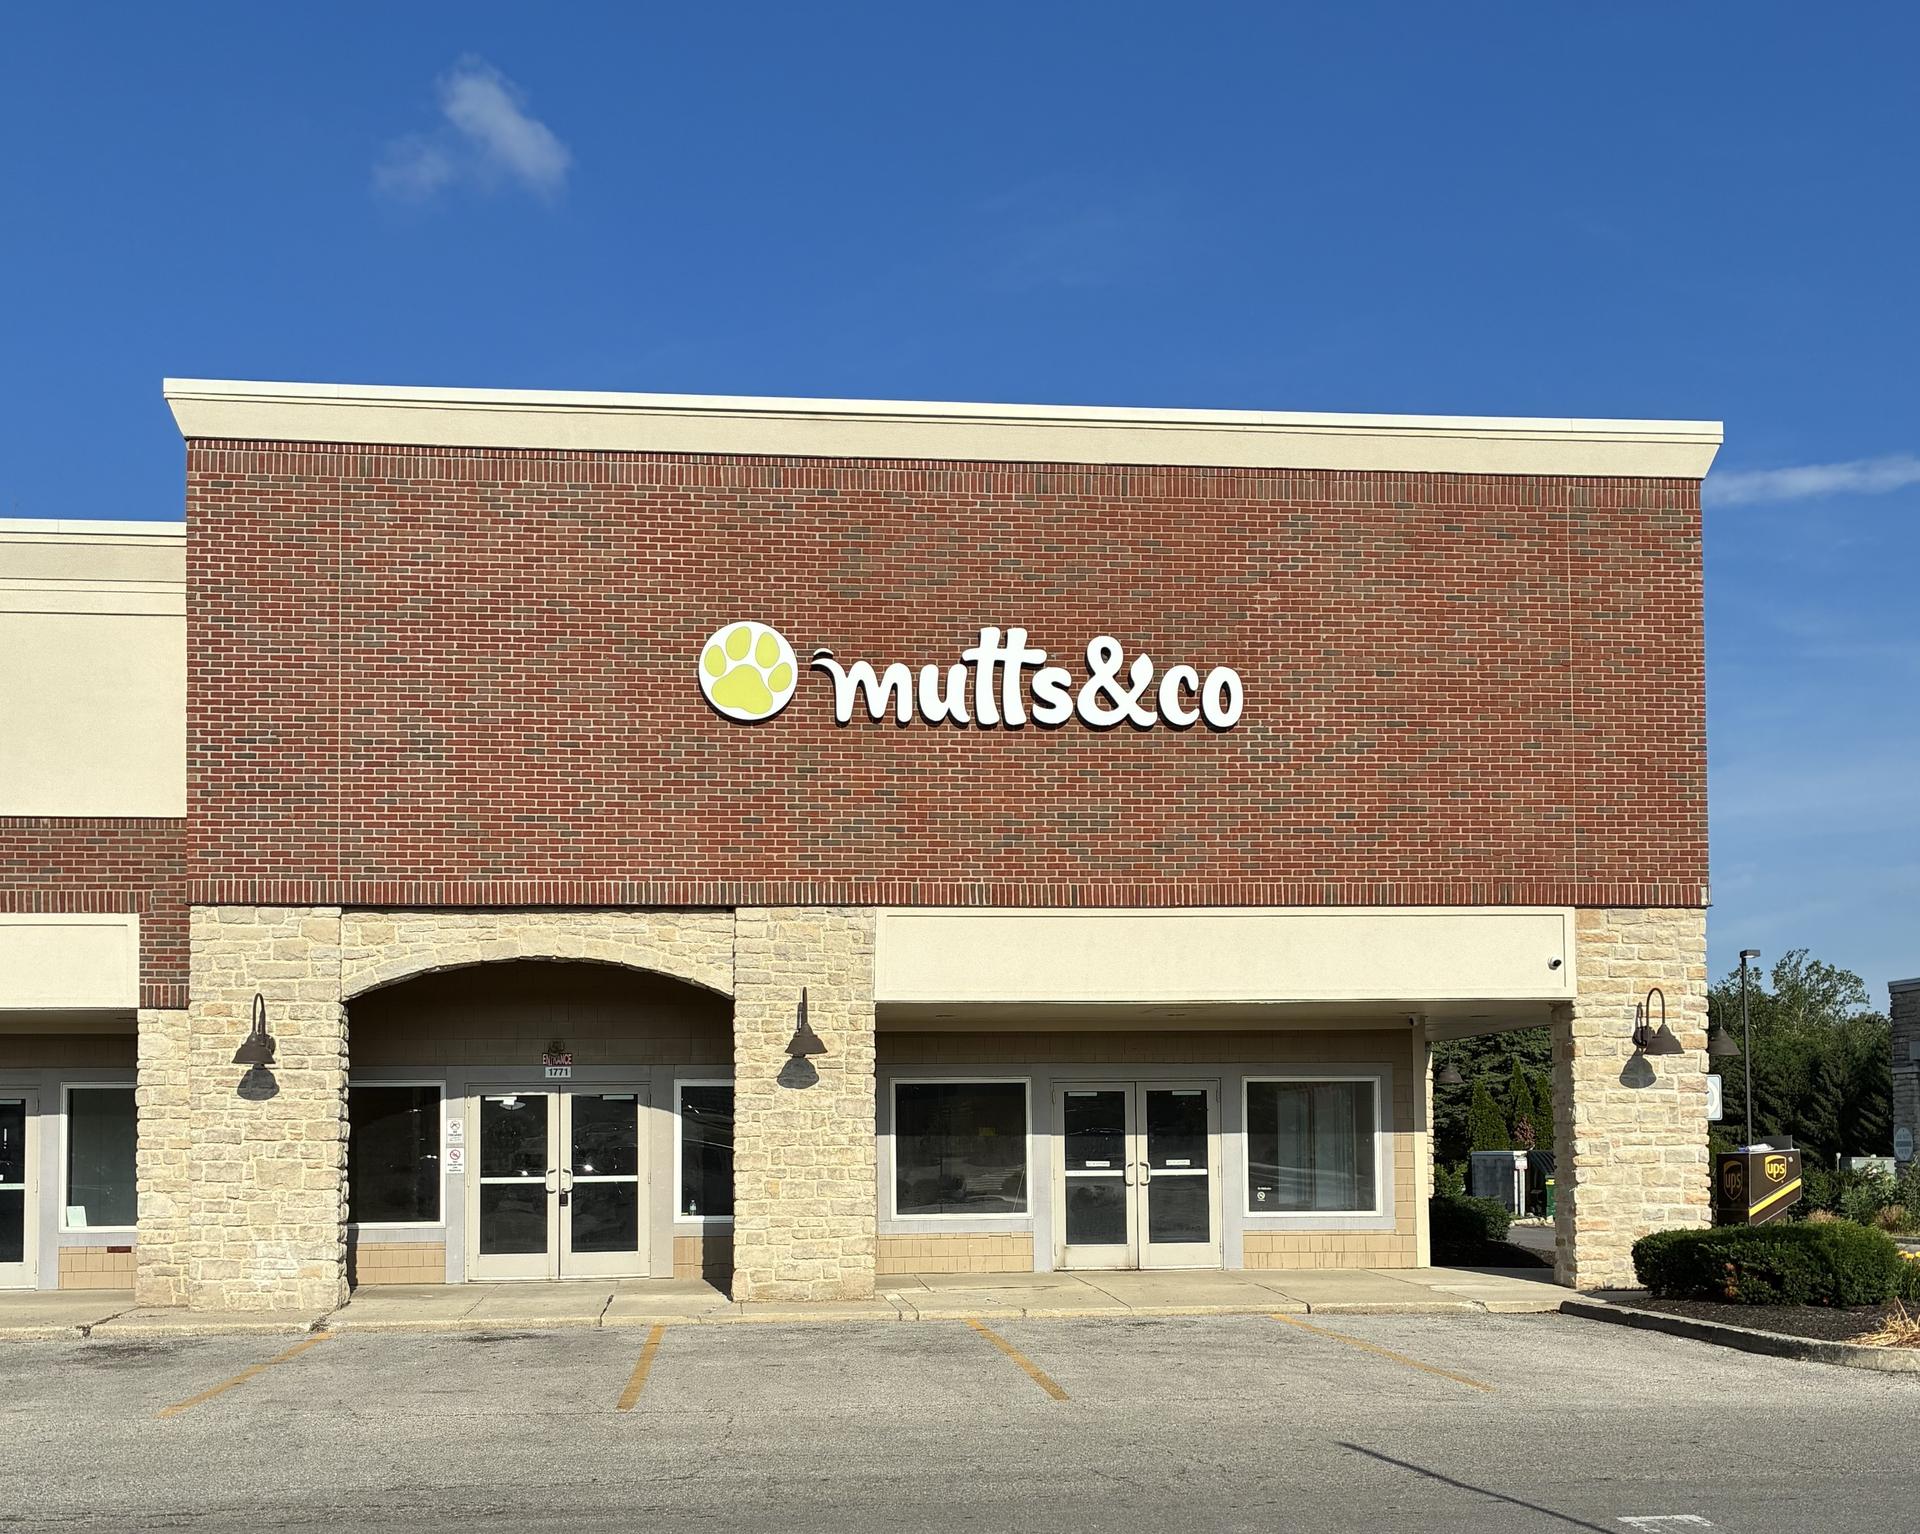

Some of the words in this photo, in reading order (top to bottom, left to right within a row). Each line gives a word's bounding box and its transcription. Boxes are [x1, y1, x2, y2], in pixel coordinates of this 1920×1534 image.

[811, 627, 1244, 729] mutts&co
[548, 1068, 568, 1076] 1771
[1767, 1163, 1785, 1178] ups
[1725, 1173, 1741, 1194] ups
